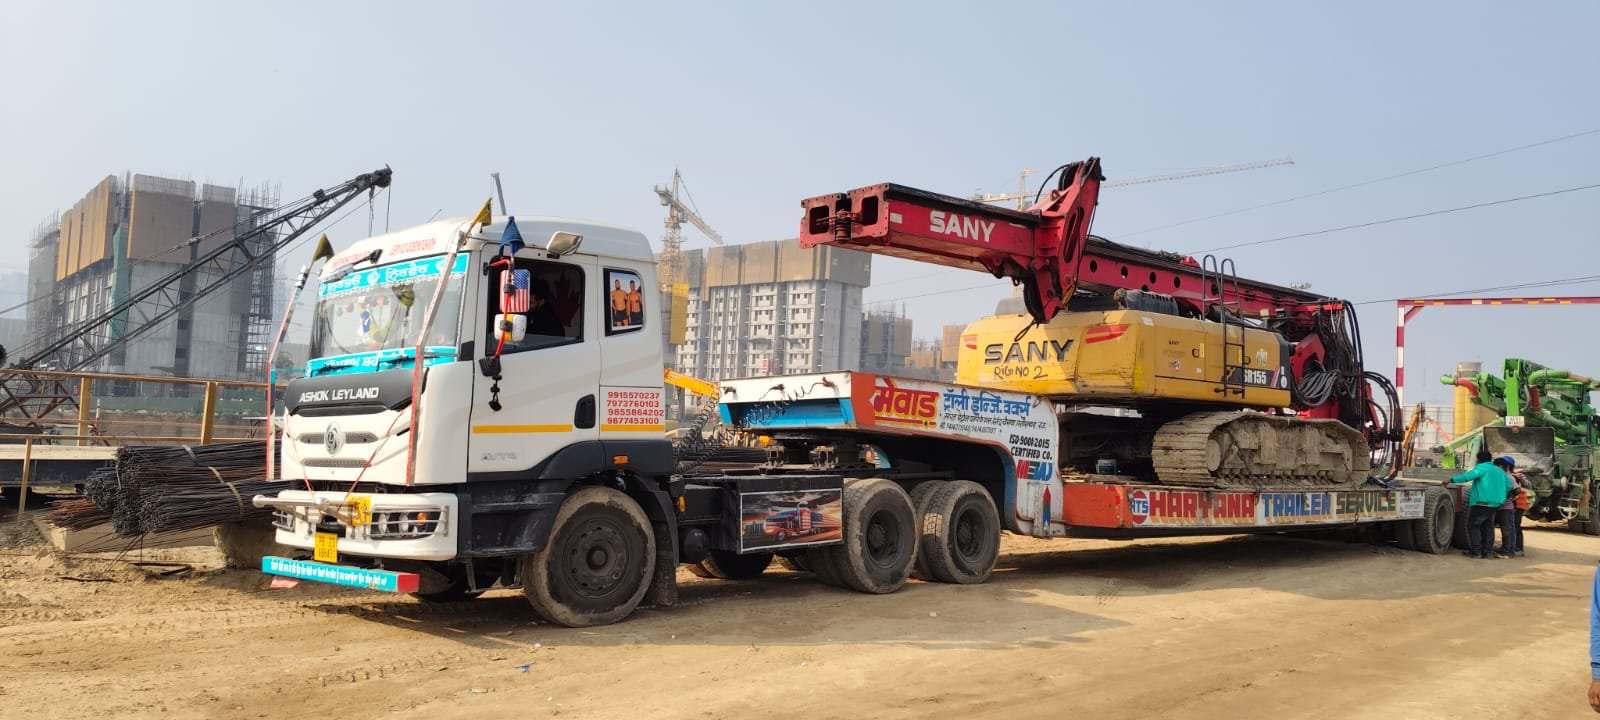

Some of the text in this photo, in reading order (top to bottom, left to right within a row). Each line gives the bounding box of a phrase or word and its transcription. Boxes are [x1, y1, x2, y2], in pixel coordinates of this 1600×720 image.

[929, 210, 996, 243] SANY
[984, 338, 1074, 364] SANY
[993, 365, 1048, 380] RIG NO 2
[299, 387, 379, 403] ASHOK LEYLAND
[607, 391, 660, 400] 9915570237
[607, 400, 660, 408] 7973760103
[607, 417, 660, 425] 9877453100
[1010, 446, 1041, 459] CERTIFIED
[1150, 491, 1255, 518] HARYANA
[1336, 491, 1397, 514] SERVICE
